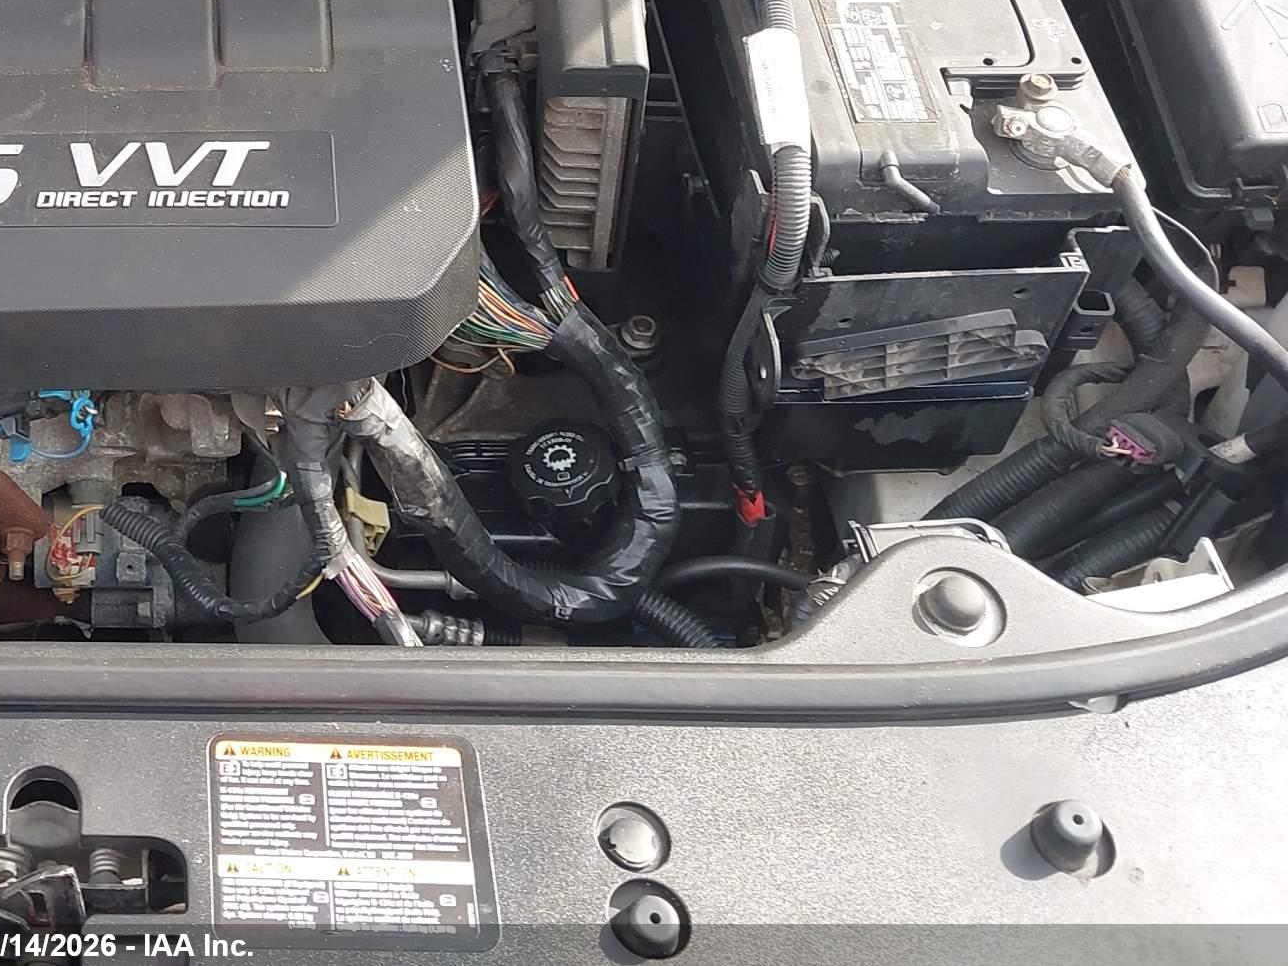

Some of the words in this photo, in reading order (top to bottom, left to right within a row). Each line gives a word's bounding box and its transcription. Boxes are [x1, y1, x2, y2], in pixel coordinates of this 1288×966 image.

[69, 141, 271, 187] VVT
[36, 190, 138, 208] DIRECT
[147, 190, 290, 208] INJECTION
[240, 746, 291, 758] WARNING
[347, 749, 435, 762] AVERTISSEMENT
